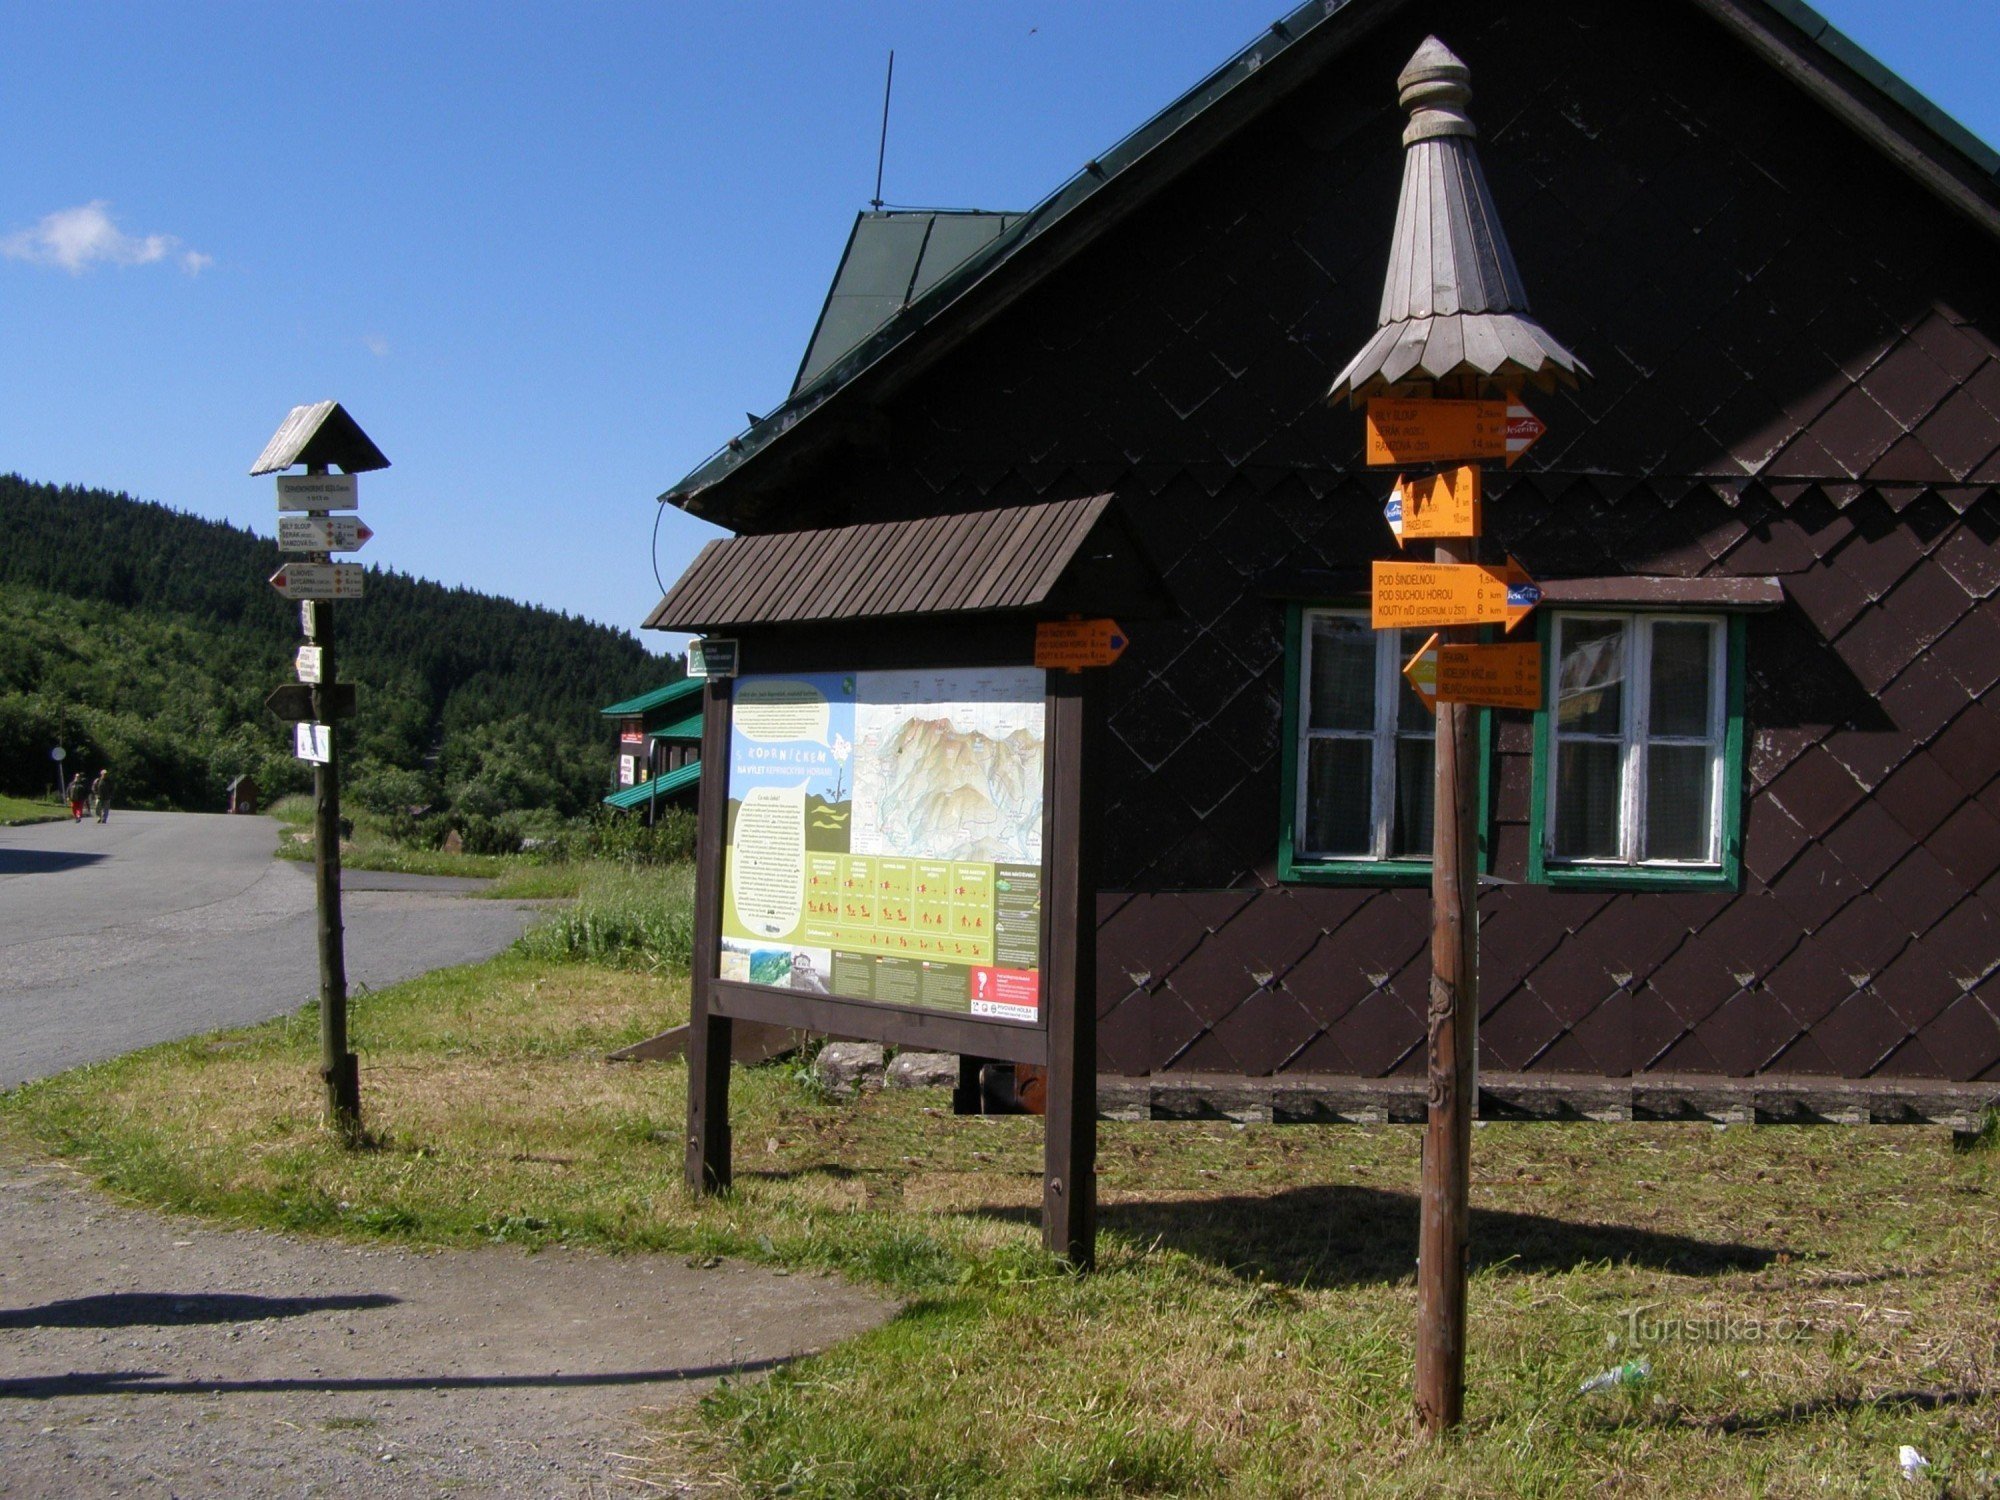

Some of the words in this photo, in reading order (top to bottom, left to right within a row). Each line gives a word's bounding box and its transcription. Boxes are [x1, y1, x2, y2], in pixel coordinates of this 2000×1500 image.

[1378, 574, 1394, 585] POD
[1395, 572, 1436, 585] ŠINDELNOU
[1378, 590, 1394, 601] POD
[1395, 589, 1426, 601] SUCHOU
[1427, 588, 1453, 600] HOROU
[1477, 588, 1483, 600] 6
[1378, 604, 1403, 616] KOUTY
[1477, 604, 1483, 615] 8
[1490, 607, 1502, 615] km
